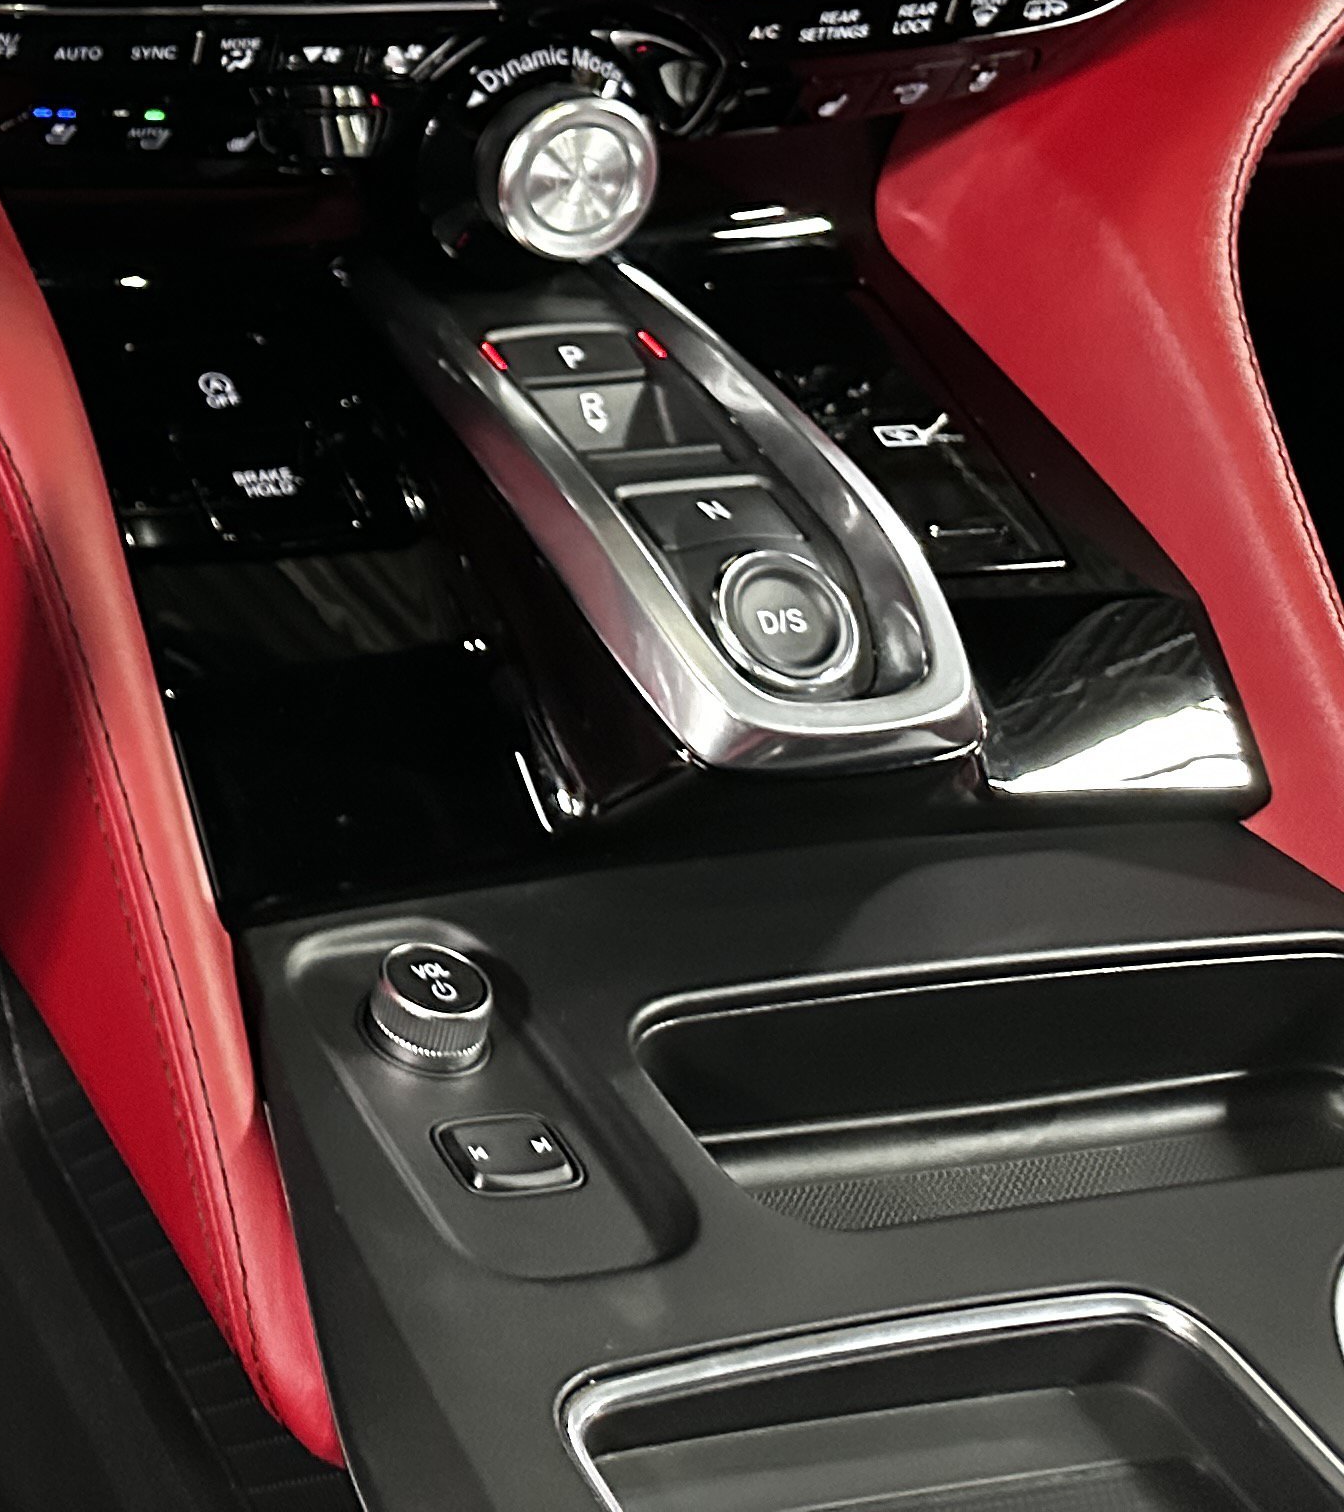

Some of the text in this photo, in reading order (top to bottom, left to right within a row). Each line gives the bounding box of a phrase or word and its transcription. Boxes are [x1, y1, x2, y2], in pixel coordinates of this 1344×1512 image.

[897, 1, 939, 19] REAR
[748, 23, 782, 40] A/C
[798, 23, 871, 43] SETTINGS
[892, 17, 934, 36] LOCK
[130, 45, 179, 61] SYNC
[220, 37, 263, 51] MODE
[53, 46, 104, 62] AUTO
[476, 44, 624, 94] Dynamic Mode
[558, 345, 585, 369] P
[579, 392, 607, 420] R
[232, 466, 295, 487] BRAKE
[244, 484, 298, 498] HOLD
[696, 500, 734, 520] N
[756, 607, 809, 635] D/S
[411, 961, 453, 980] VOL
